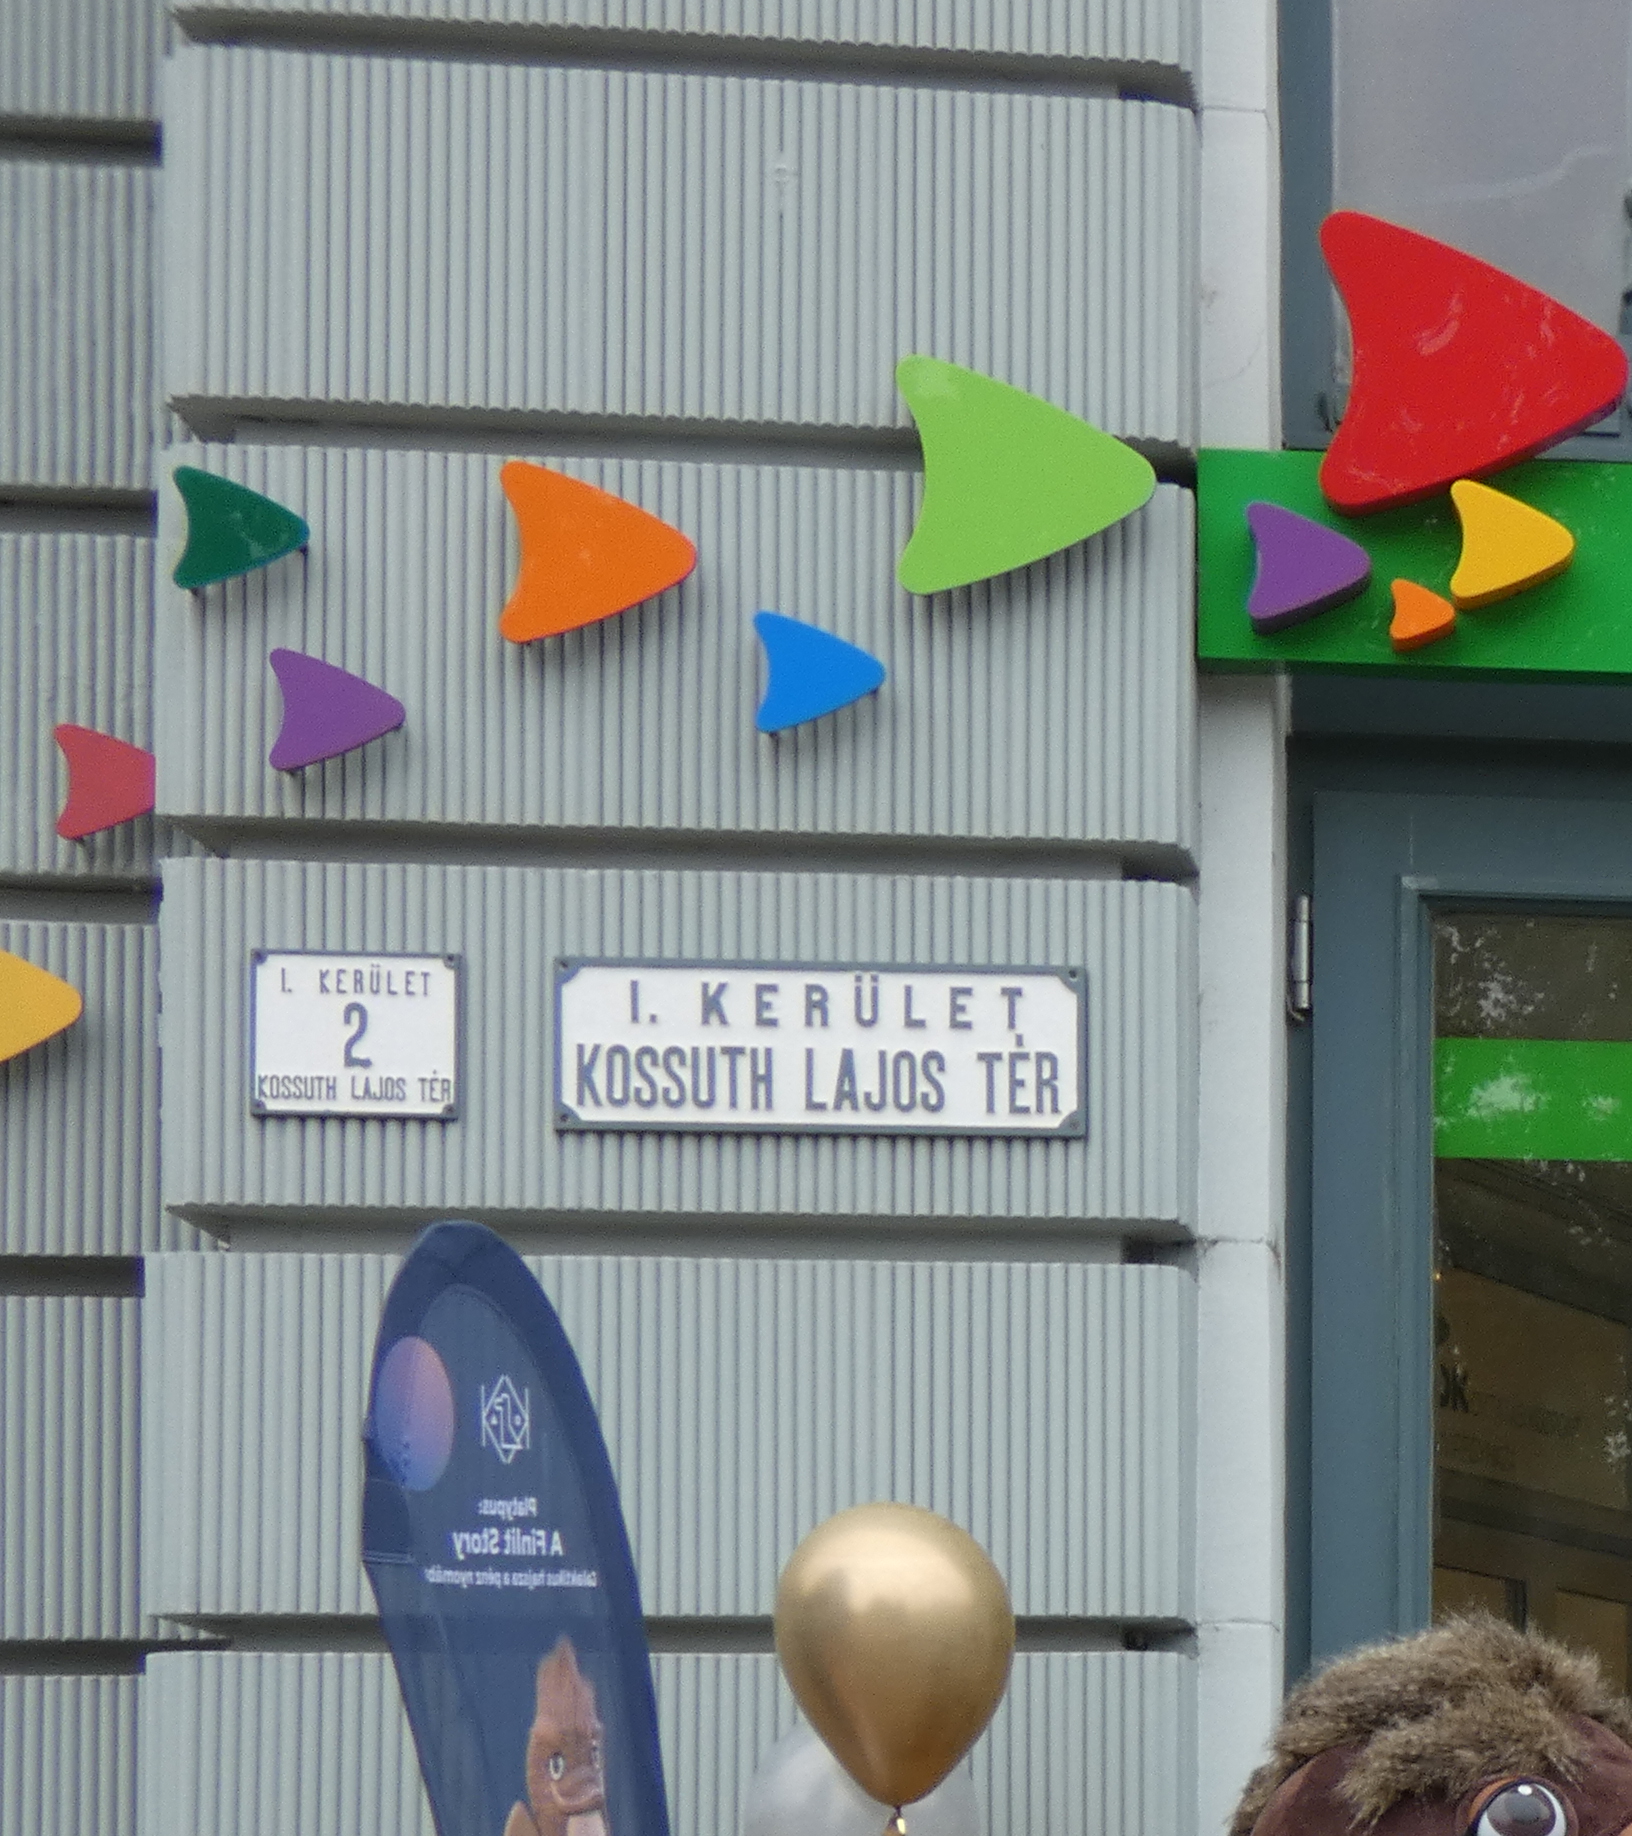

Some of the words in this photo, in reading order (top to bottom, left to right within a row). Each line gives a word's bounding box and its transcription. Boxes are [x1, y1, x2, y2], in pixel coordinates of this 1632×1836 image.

[281, 967, 292, 993] I.
[319, 963, 431, 997] KERÜLET
[629, 979, 658, 1025] I.
[700, 973, 1023, 1031] KERÜLET
[343, 1001, 373, 1069] 2
[257, 1073, 337, 1101] KOSSUTH
[350, 1075, 407, 1101] LAJOS
[417, 1069, 452, 1103] TÉR
[575, 1043, 774, 1112] KOSSUTH
[805, 1047, 946, 1114] LAJOS
[976, 1033, 1063, 1115] TÉR
